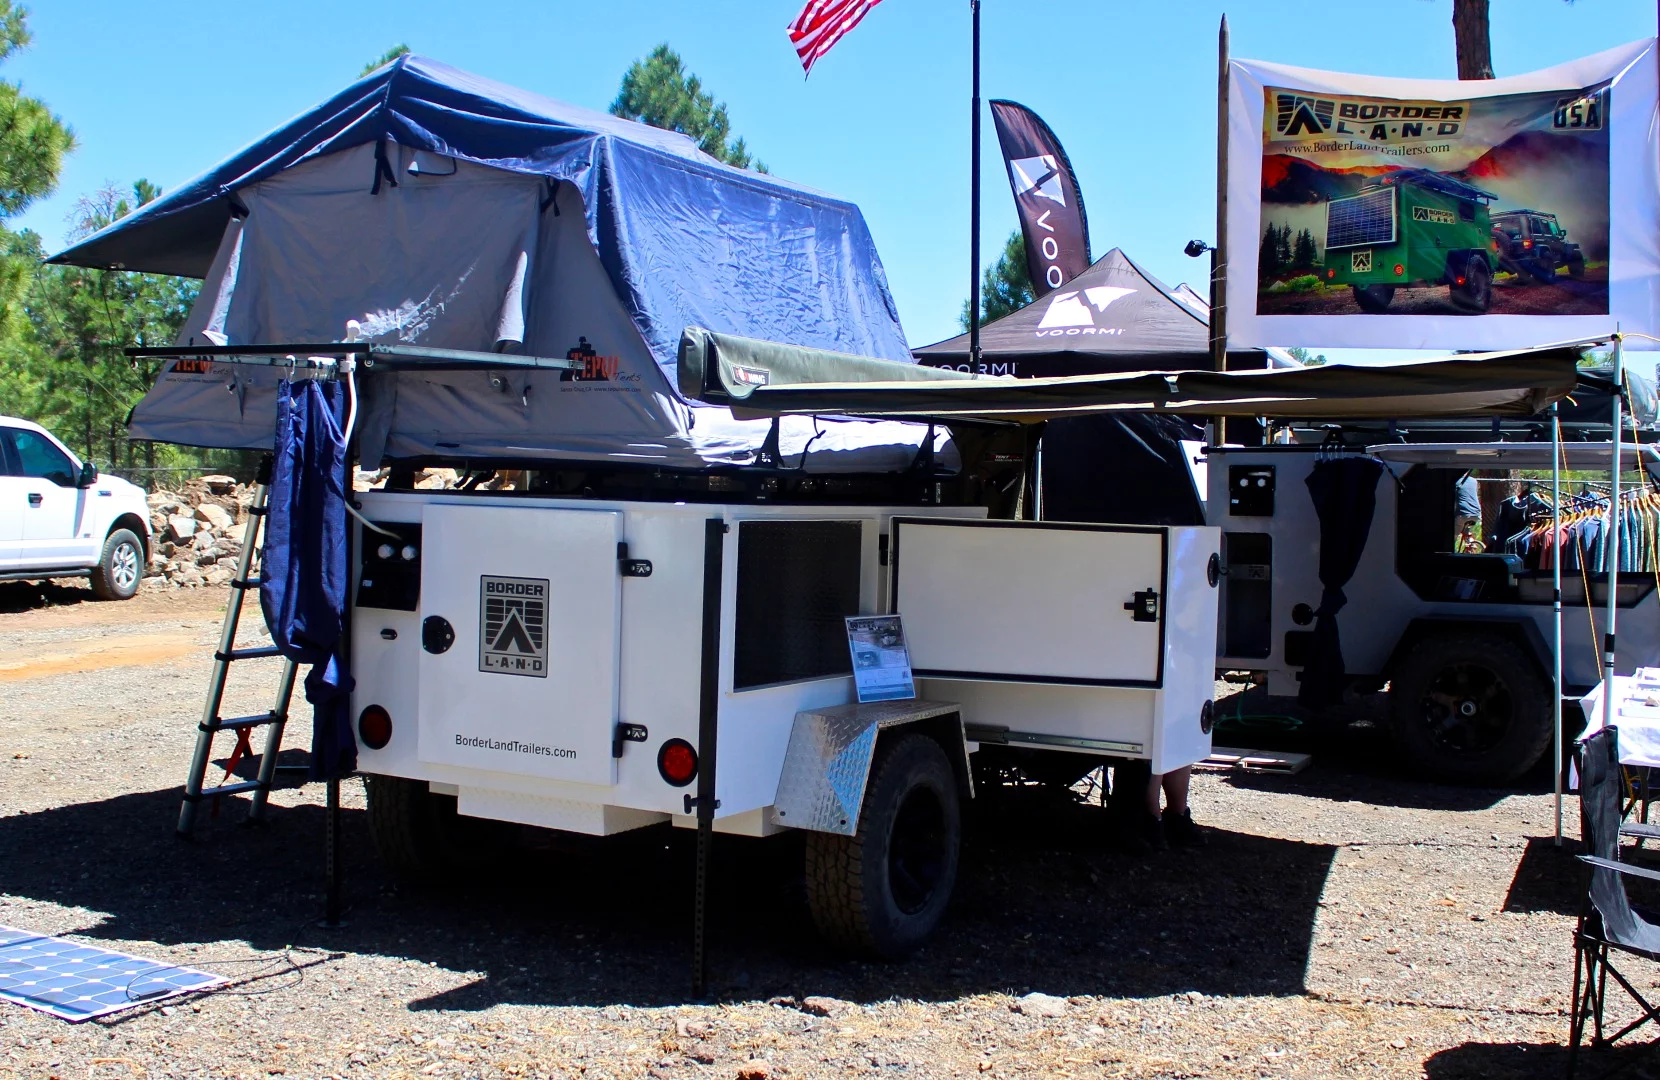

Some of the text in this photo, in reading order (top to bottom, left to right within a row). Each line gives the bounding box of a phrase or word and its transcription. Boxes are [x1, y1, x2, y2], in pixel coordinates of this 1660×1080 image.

[1338, 103, 1464, 120] BORDER
[1553, 104, 1599, 128] USA
[1284, 141, 1450, 156] www.BorderLandTrailers.com
[1035, 328, 1122, 338] VOORMI
[486, 582, 544, 596] BORDER
[455, 734, 577, 759] BorderLandTrailers.com
